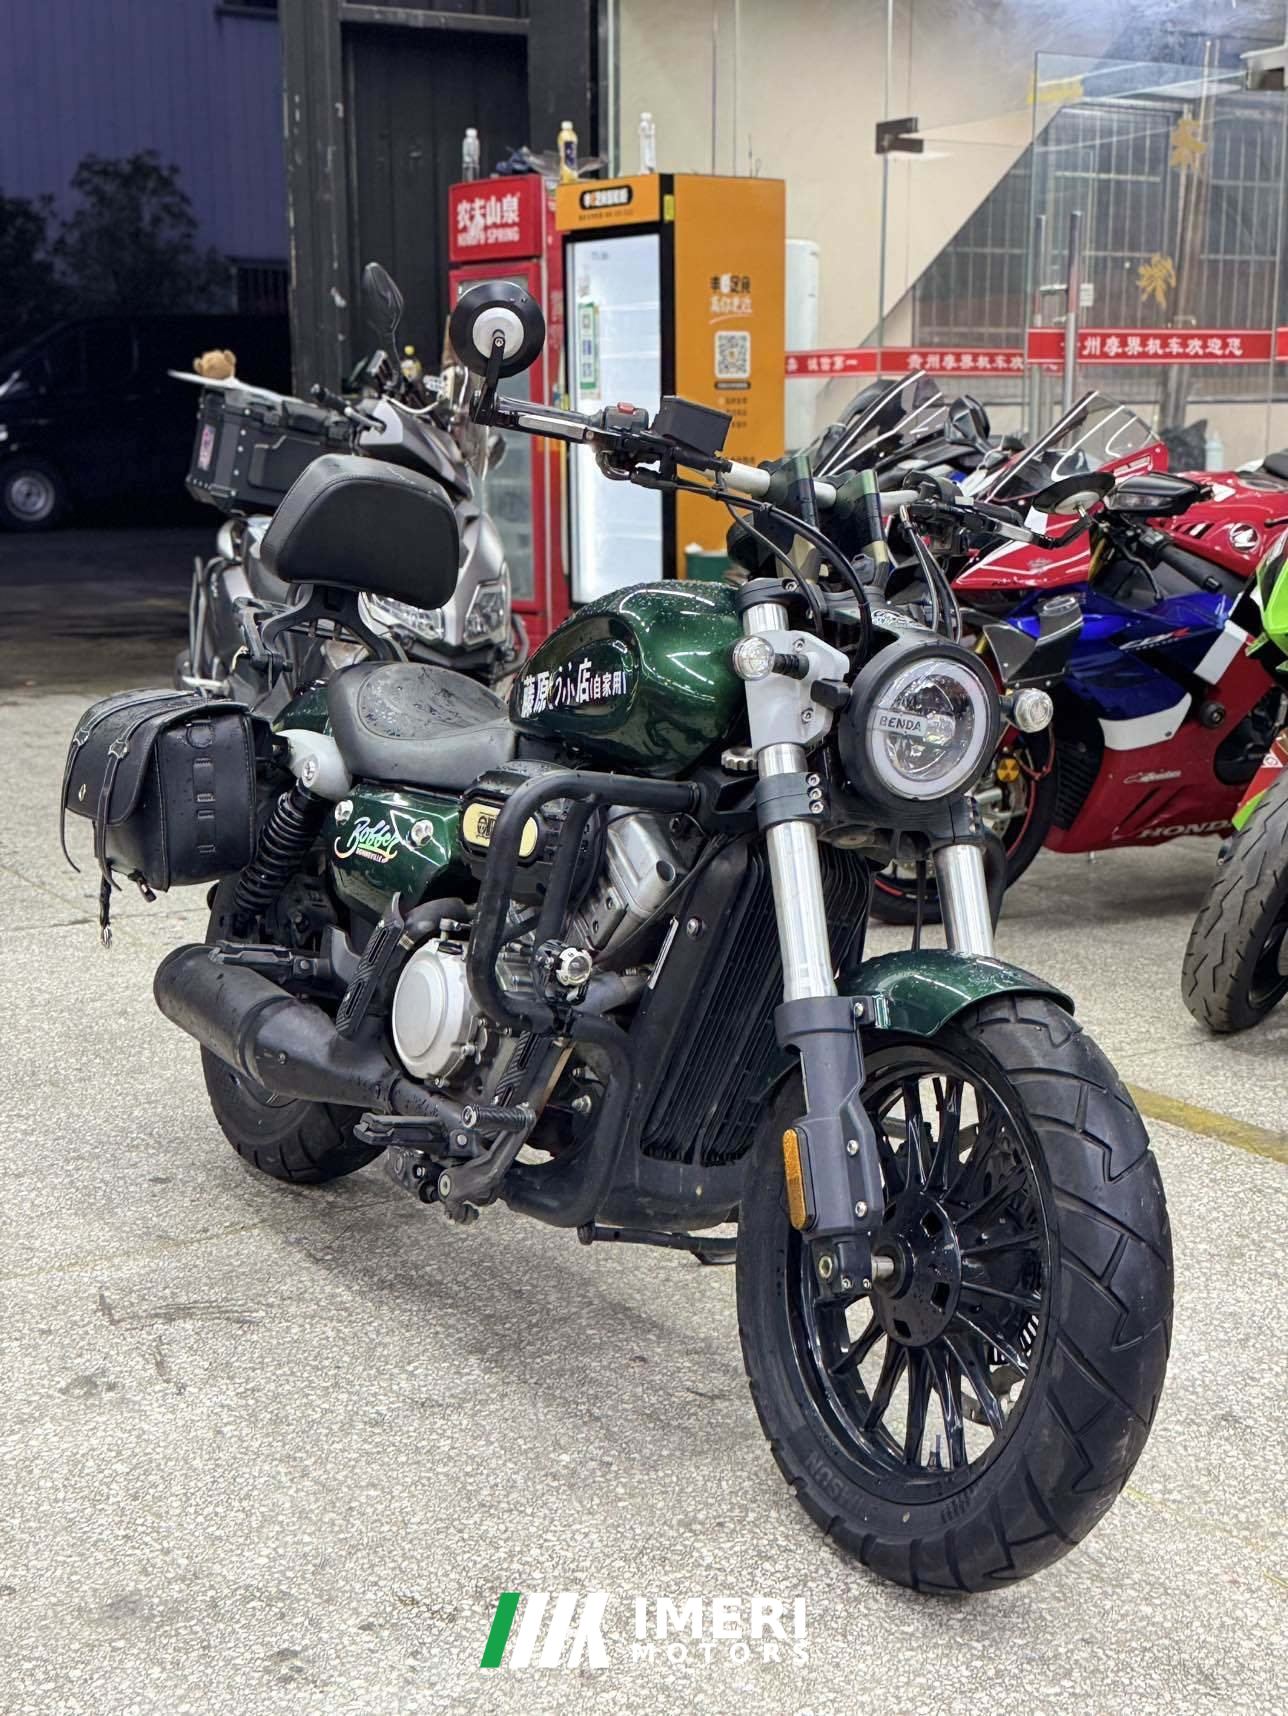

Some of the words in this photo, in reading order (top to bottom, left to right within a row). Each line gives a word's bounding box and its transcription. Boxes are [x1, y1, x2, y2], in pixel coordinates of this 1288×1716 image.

[457, 193, 520, 230] 农夫山泉
[1061, 336, 1243, 356] 州摩界机车欢迎您
[879, 715, 922, 732] BENDA
[334, 816, 401, 859] Bobber
[1138, 820, 1232, 839] HOND
